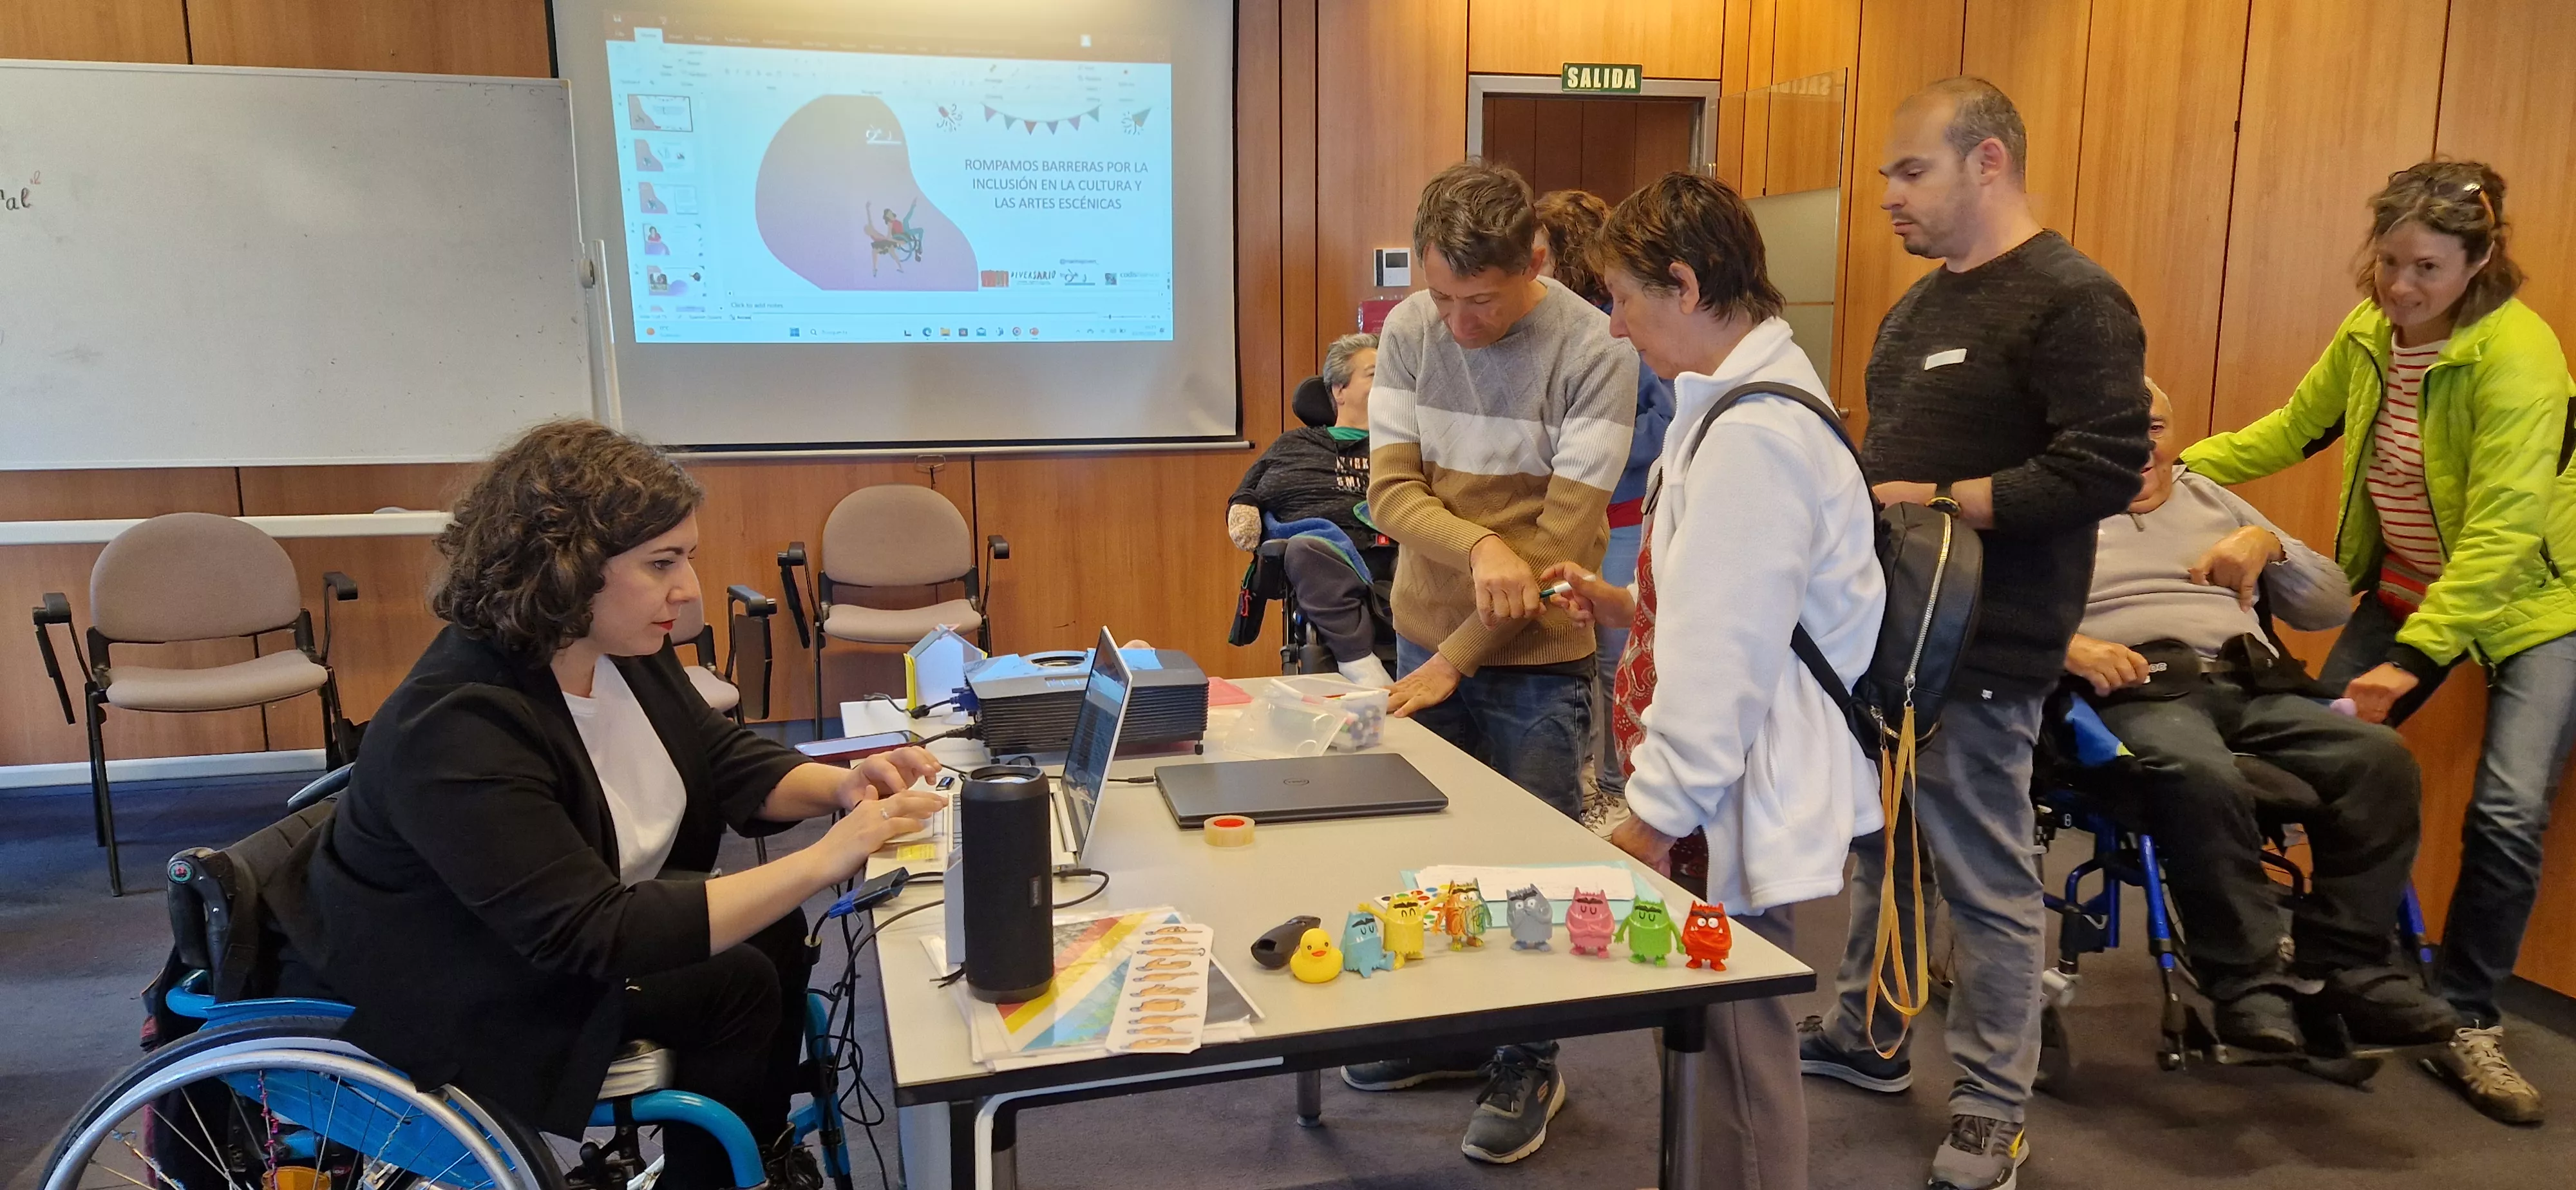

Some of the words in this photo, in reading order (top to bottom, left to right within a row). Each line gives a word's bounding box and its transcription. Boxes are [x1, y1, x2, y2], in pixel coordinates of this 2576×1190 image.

[1567, 66, 1636, 89] SALIDA
[965, 159, 1039, 172] ROMPAMOS
[1042, 160, 1104, 173] BARRERAS
[1107, 161, 1132, 173] POR
[1135, 162, 1148, 173] LA
[972, 176, 1038, 191] INCLUSIÓN
[1041, 179, 1057, 191] EN
[1061, 180, 1075, 191] LA
[1078, 179, 1132, 191] CULTURA
[1135, 180, 1142, 191] Y
[994, 197, 1016, 209] LAS
[1019, 197, 1056, 209] ARTES
[1059, 195, 1122, 210] ESCÉNICAS
